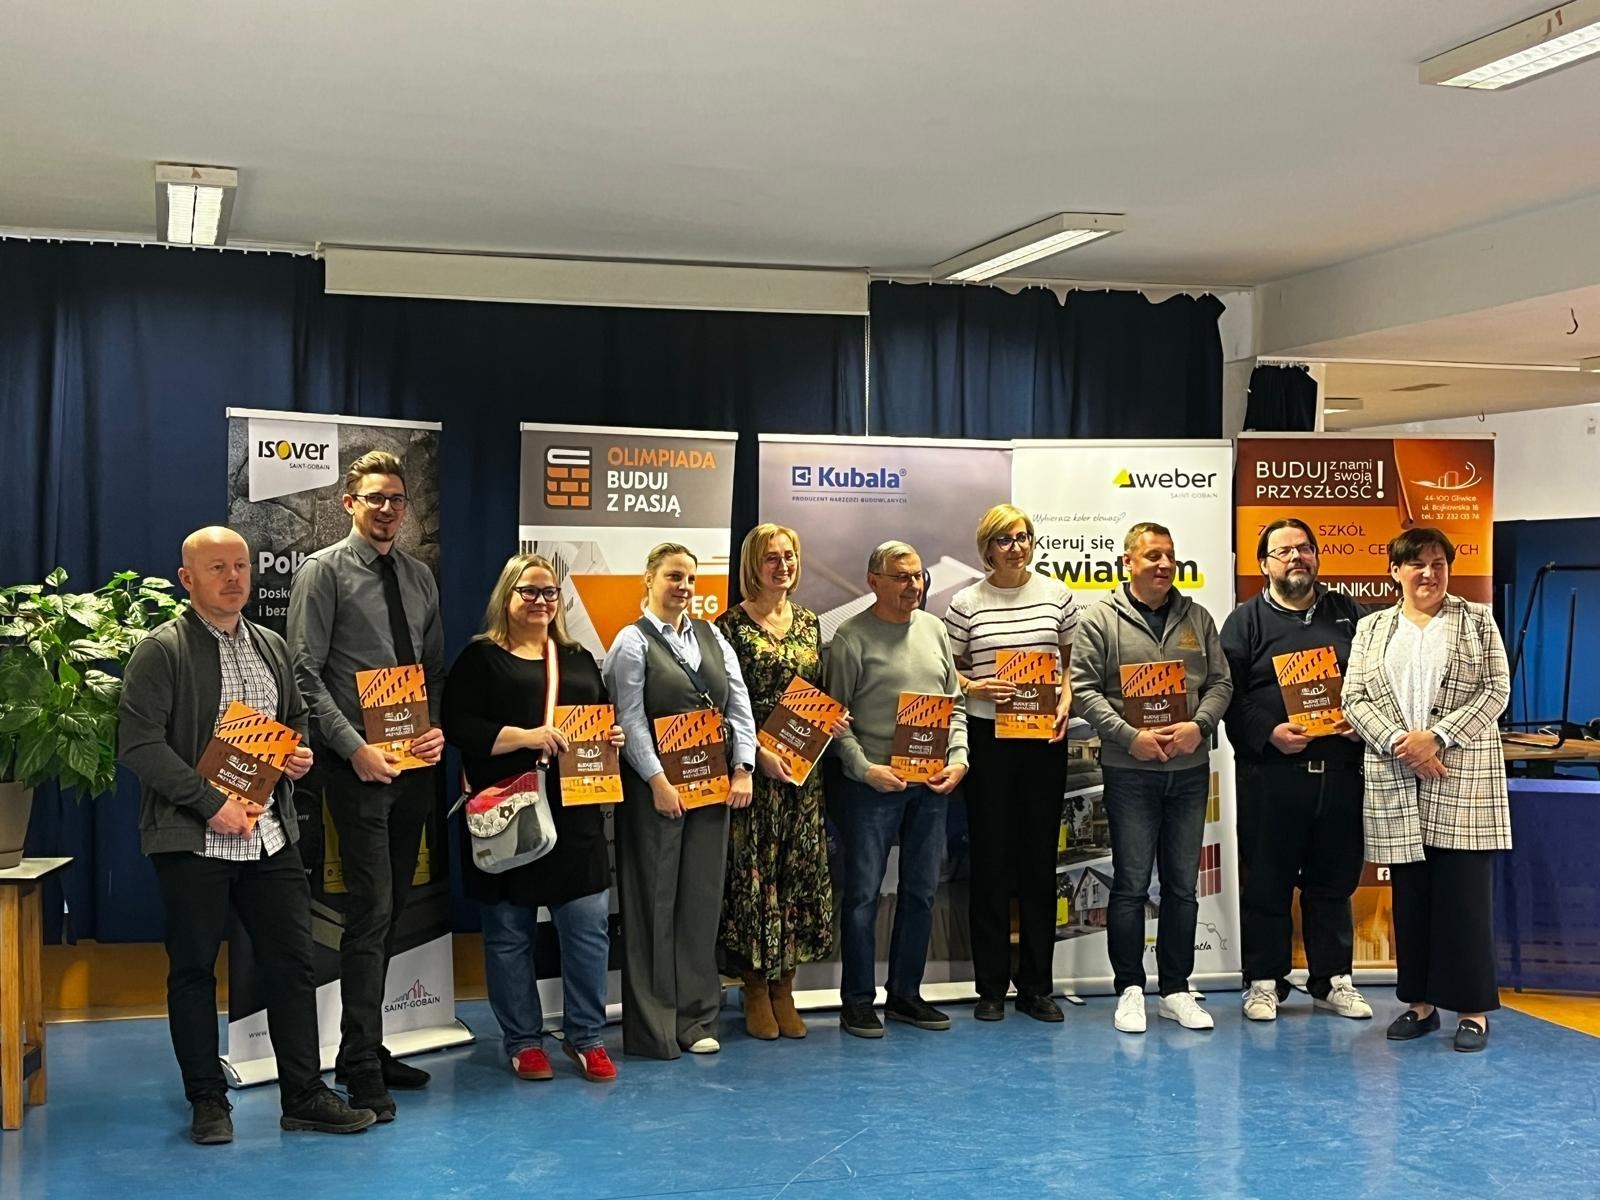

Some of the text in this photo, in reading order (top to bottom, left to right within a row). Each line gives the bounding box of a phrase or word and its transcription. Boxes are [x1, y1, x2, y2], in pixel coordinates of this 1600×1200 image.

[607, 446, 717, 469] OLIMPIADA
[289, 463, 330, 471] SAINT-GOBAIN
[1256, 459, 1373, 484] BUDUJ z nami
[607, 471, 668, 490] BUDUJ
[1135, 468, 1217, 488] weber
[1334, 470, 1373, 484] swoją
[1256, 481, 1372, 499] PRZYSZŁOŚĆ
[606, 493, 682, 517] Z PASJĄ
[1432, 503, 1470, 512] Bojkowska
[1319, 521, 1366, 537] SZKÓŁ
[1034, 535, 1115, 551] Kieruj się
[384, 996, 441, 1013] SAINT-GOBAIN
